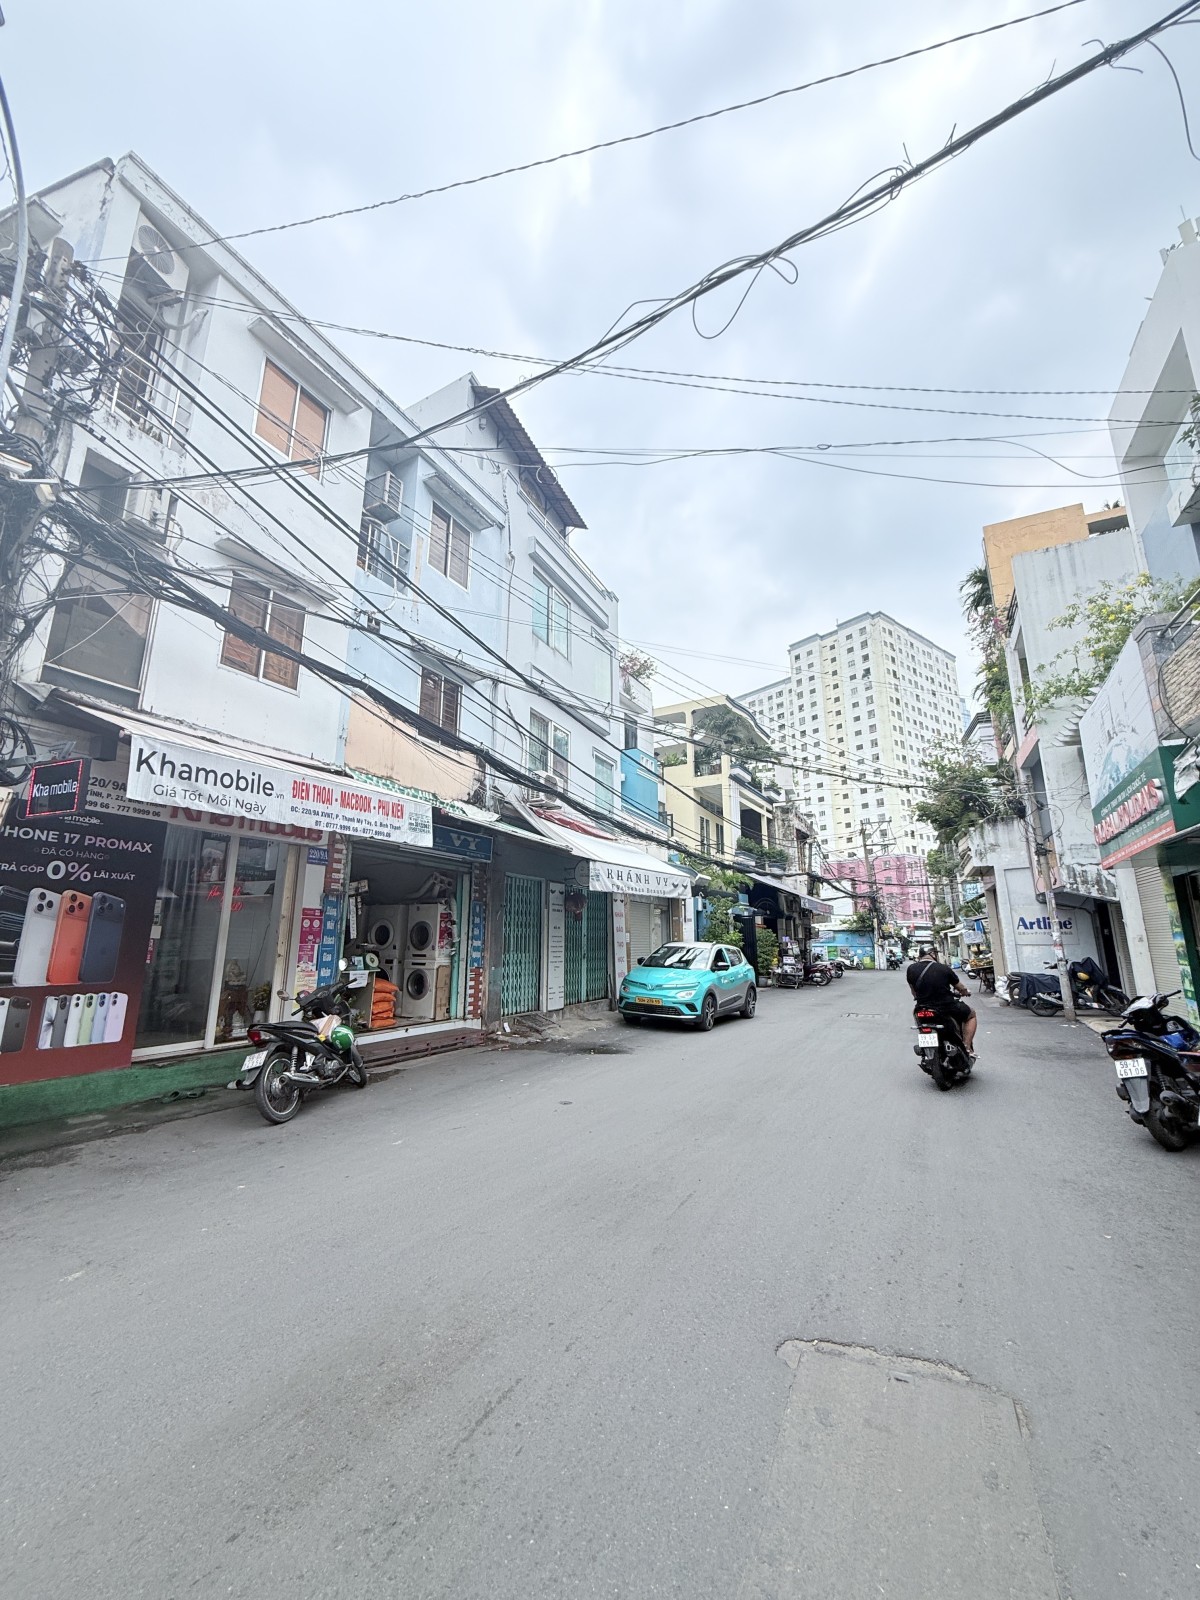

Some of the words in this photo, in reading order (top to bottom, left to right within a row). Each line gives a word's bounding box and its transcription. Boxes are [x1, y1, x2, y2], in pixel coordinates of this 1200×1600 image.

[88, 776, 127, 792] 20/9A
[153, 784, 177, 798] Giá
[183, 789, 203, 803] Tốt
[208, 793, 231, 807] Mỗi
[235, 798, 267, 815] Ngày
[292, 778, 311, 805] ĐIỆN
[312, 784, 333, 809] THOẠI
[340, 791, 373, 813] MACBOOK
[377, 799, 390, 820] PHỤ
[391, 800, 404, 822] KIỆN
[117, 805, 130, 813] 777
[133, 808, 150, 816] 9999
[64, 832, 80, 845] 17
[84, 835, 152, 854] PROMAX
[41, 847, 57, 855] ĐÃ
[59, 848, 74, 857] CÓ
[76, 850, 104, 860] HÀNG
[20, 863, 45, 873] GÓP
[46, 860, 91, 882] 0%
[94, 870, 109, 879] LÃI
[111, 871, 136, 881] XUẤT
[656, 876, 669, 887] VY
[1017, 917, 1072, 930] Artlie
